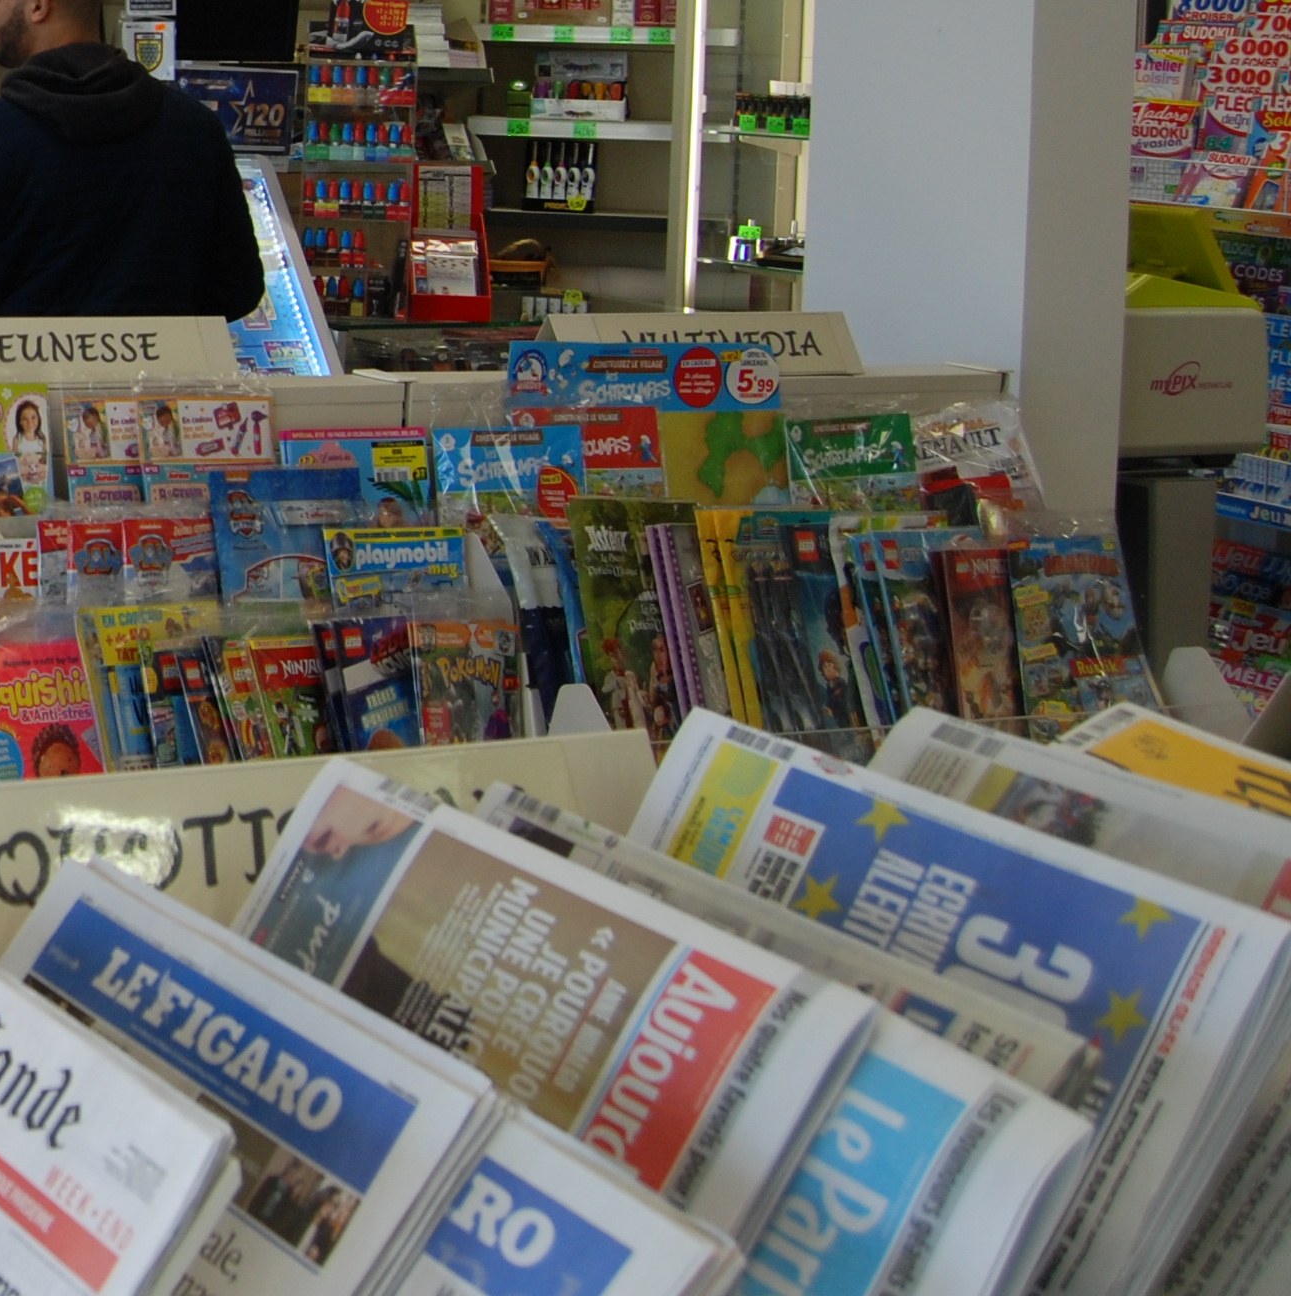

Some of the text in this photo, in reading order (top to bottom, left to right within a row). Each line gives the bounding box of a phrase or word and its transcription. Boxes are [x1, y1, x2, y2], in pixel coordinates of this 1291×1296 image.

[1183, 23, 1236, 39] SUDOKU
[1224, 40, 1289, 55] 6000
[1135, 71, 1180, 85] Loisirs
[1207, 68, 1271, 84] 3000
[244, 103, 285, 127] 120
[1131, 126, 1189, 140] SUDOKU
[1135, 138, 1182, 149] évasion
[1205, 135, 1234, 150] 84
[1208, 153, 1250, 165] SUDOKU
[1233, 265, 1284, 282] CODES
[639, 359, 664, 369] VILLAGE
[691, 359, 712, 367] CADEAU
[605, 371, 618, 381] les
[578, 379, 671, 406] SCHTROUMPFS
[182, 415, 213, 425] En cadeau
[355, 540, 449, 570] playmobil
[428, 564, 459, 577] mag
[344, 636, 362, 648] LEGO
[502, 907, 557, 972] UNE
[426, 876, 540, 1051] MUNICIPALE
[531, 952, 569, 983] JE
[92, 947, 344, 1131] LE FIGARO
[449, 1175, 555, 1267] RO
